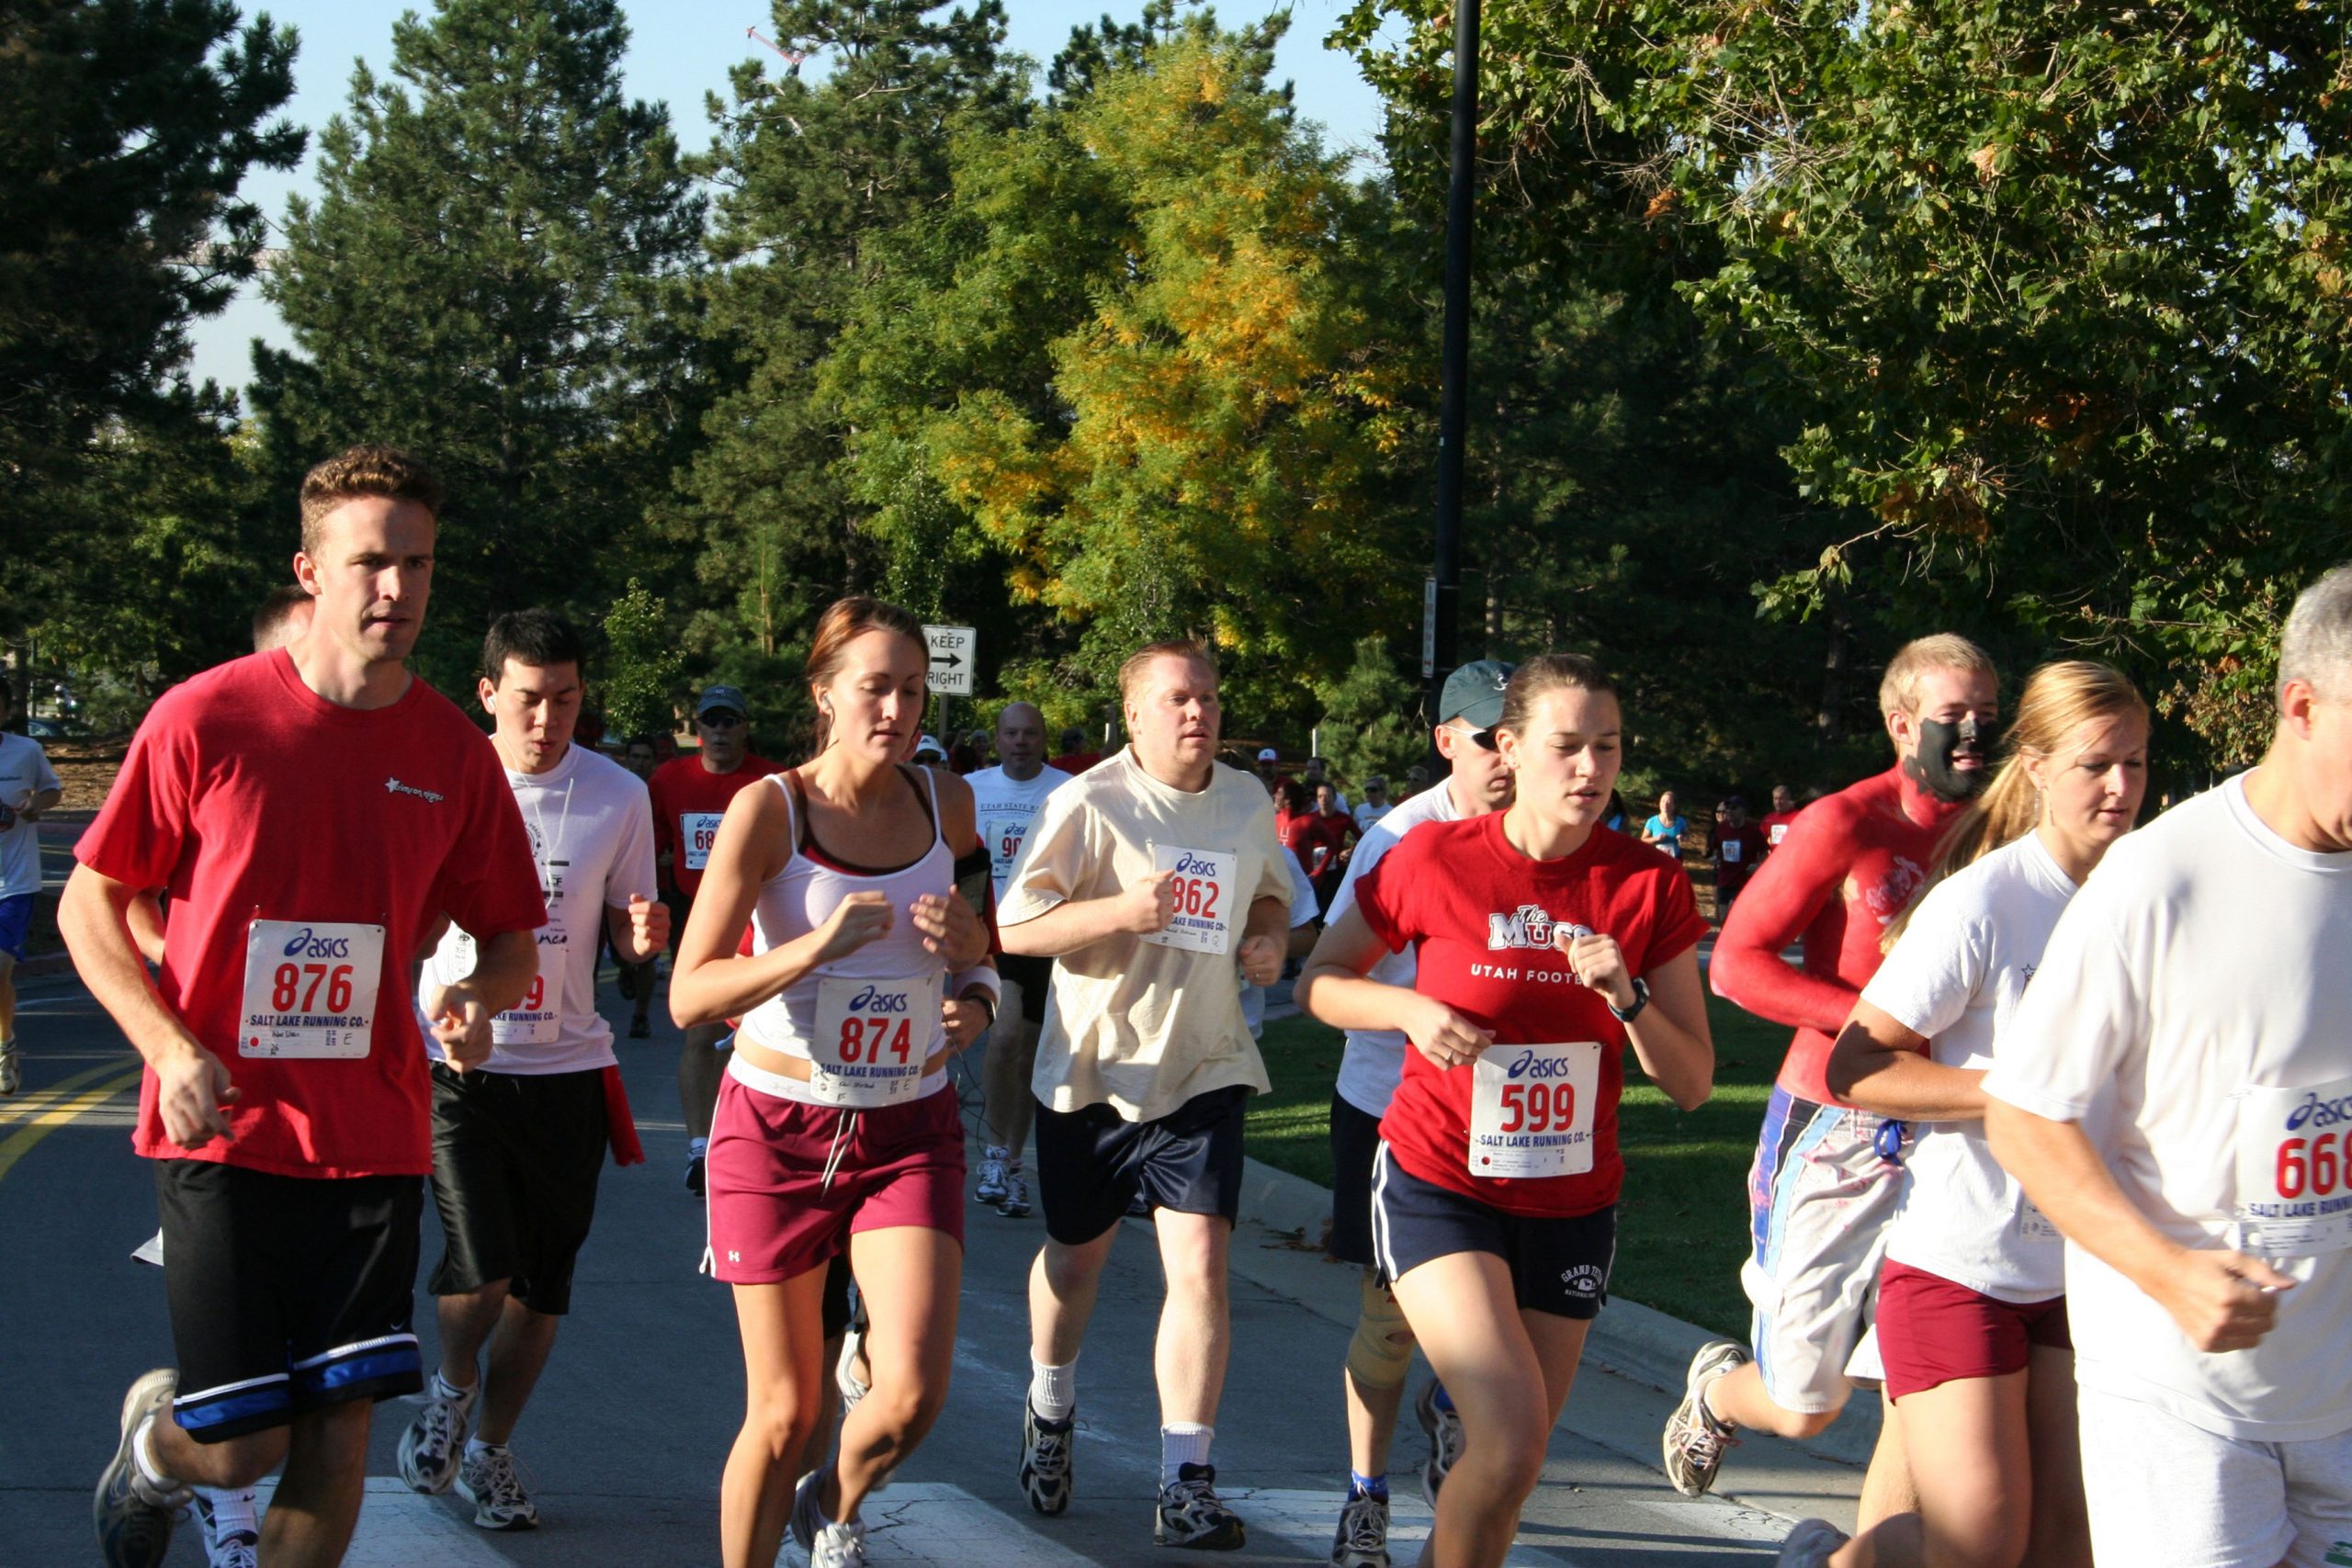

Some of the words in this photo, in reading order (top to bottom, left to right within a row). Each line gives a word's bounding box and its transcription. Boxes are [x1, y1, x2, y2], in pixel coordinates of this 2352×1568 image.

[931, 636, 965, 649] KEEP
[927, 671, 964, 685] RIGHT
[1172, 876, 1219, 919] 862
[1517, 906, 1547, 922] The
[1188, 919, 1214, 930] RUNNING
[1471, 964, 1518, 979] UTAH
[272, 963, 354, 1013] 876
[251, 1015, 274, 1026] SALT
[277, 1016, 300, 1026] LAKE
[302, 1016, 346, 1027] RUNNING
[509, 1012, 542, 1021] RUNNING
[839, 1016, 910, 1065] 874
[820, 1063, 842, 1075] SALT
[844, 1066, 866, 1077] LAKE
[869, 1066, 906, 1077] RUNNING
[1499, 1082, 1575, 1133] 599
[1480, 1134, 1504, 1146] SALT
[1507, 1136, 1530, 1147] LAKE
[1532, 1134, 1572, 1147] RUNNING
[2276, 1127, 2352, 1200] 66
[2249, 1202, 2279, 1217] SALT
[2283, 1201, 2316, 1217] LAKE
[1561, 1264, 1590, 1283] GRAND
